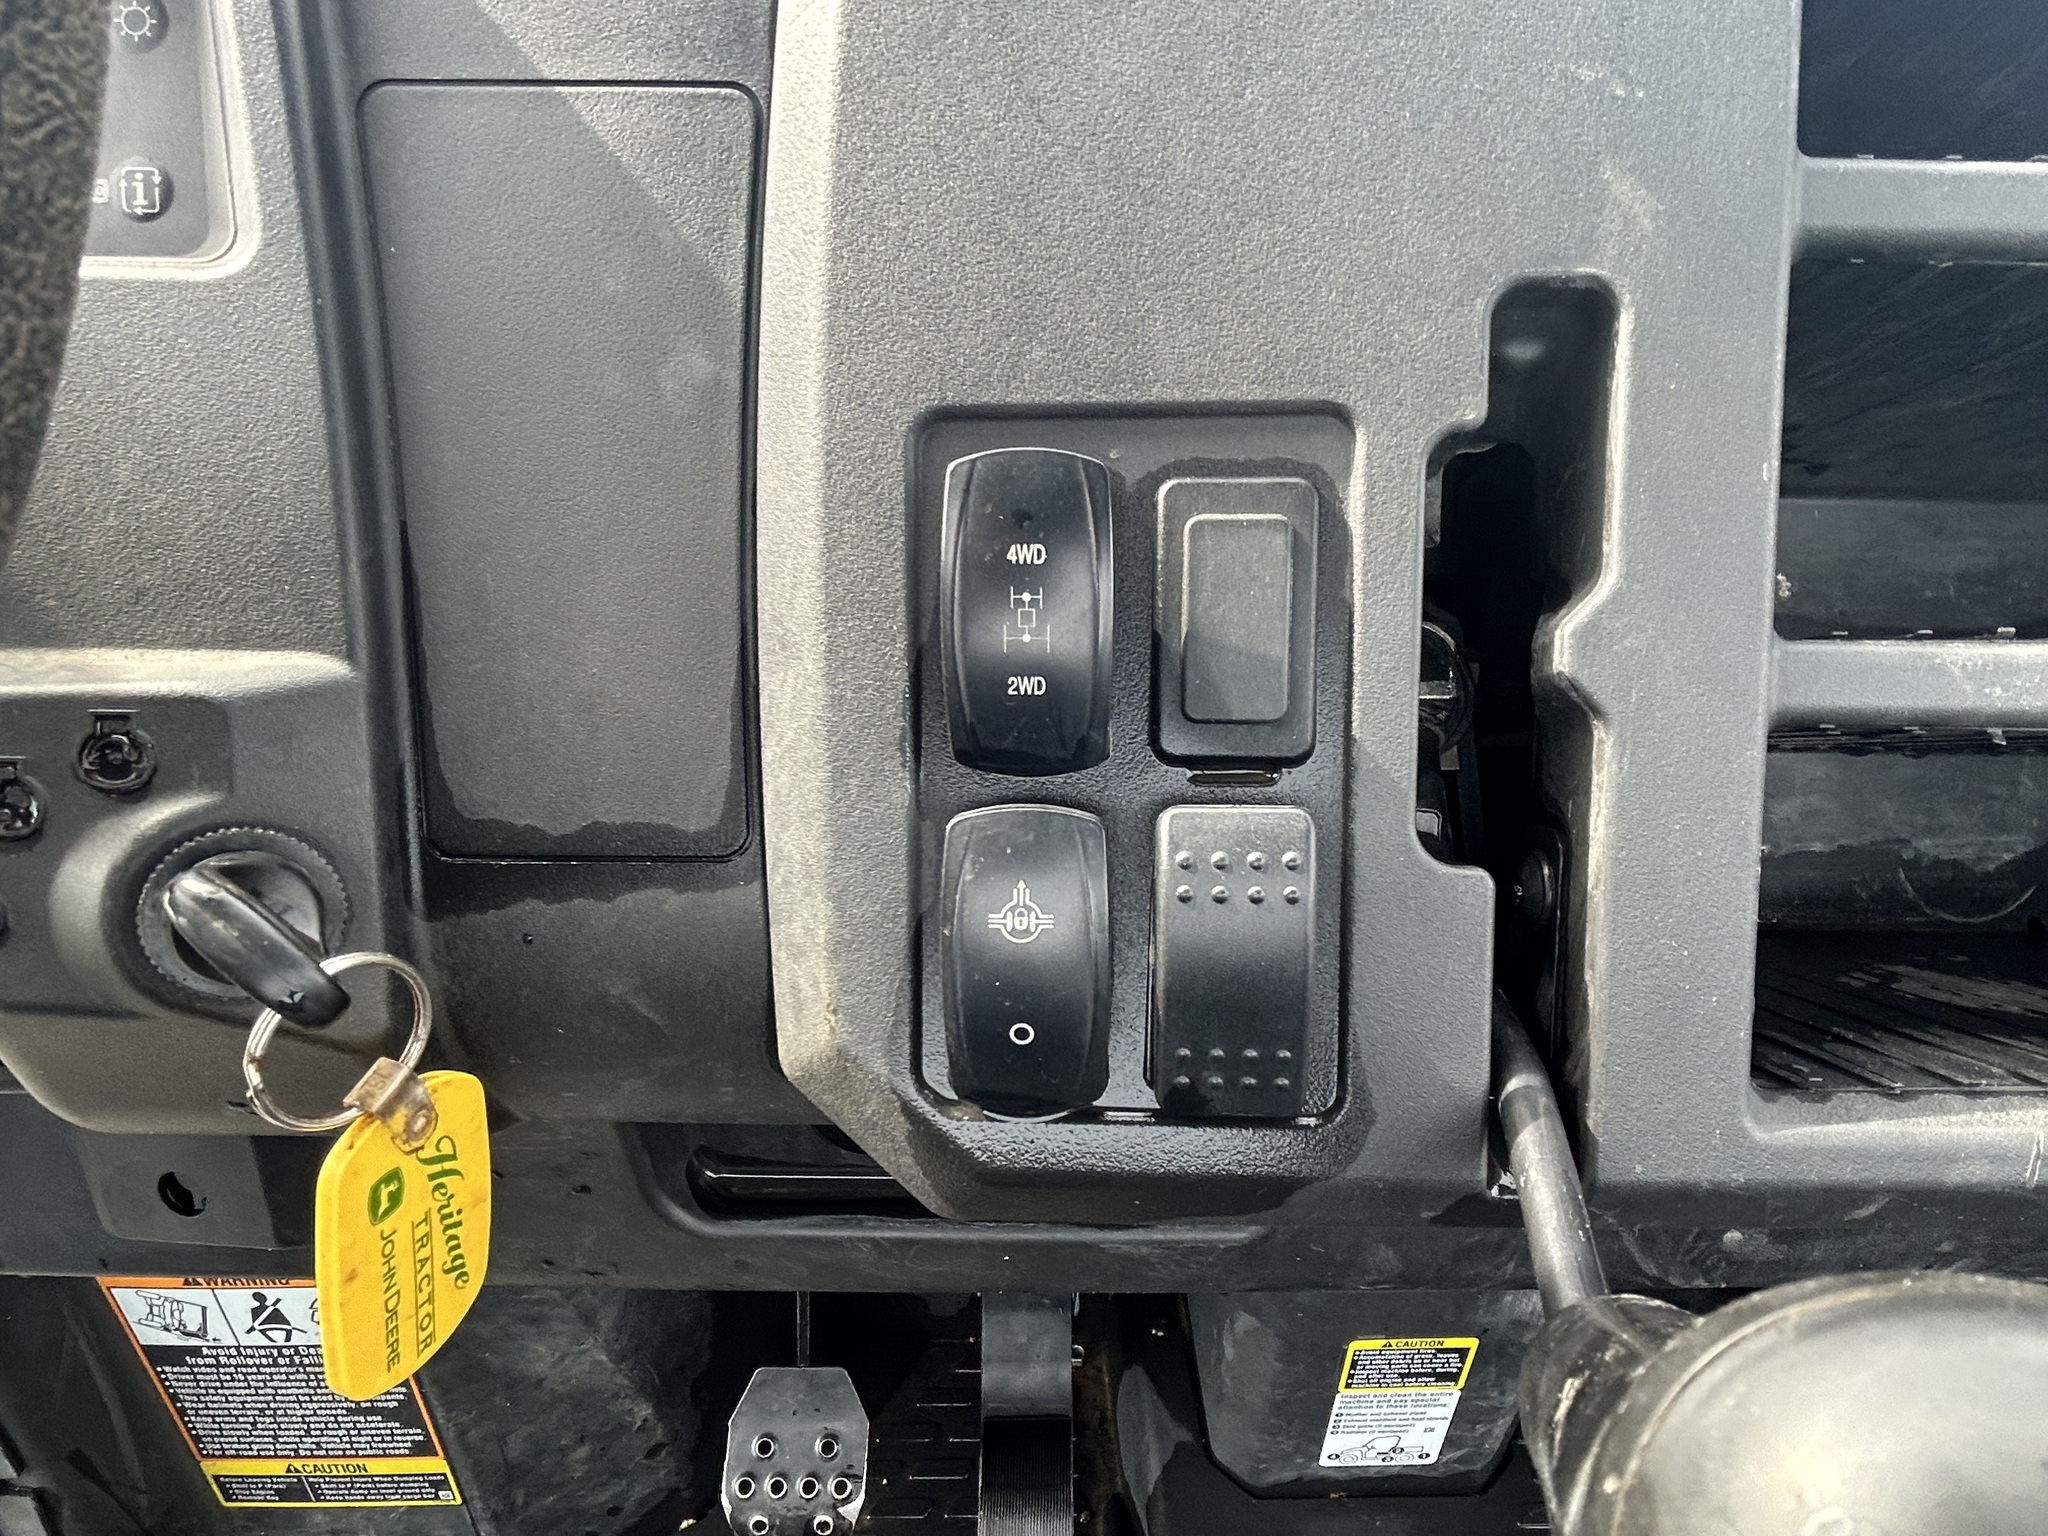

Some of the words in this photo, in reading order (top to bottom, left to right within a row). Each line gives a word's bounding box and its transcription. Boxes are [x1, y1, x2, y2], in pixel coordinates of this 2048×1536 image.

[1006, 544, 1047, 565] 4WD
[1007, 676, 1047, 696] 2WD
[416, 1135, 471, 1290] Heritage
[414, 1210, 434, 1354] TRACTOR
[202, 1347, 237, 1355] Avoid
[240, 1347, 278, 1356] Injury
[282, 1346, 294, 1355] or
[298, 1346, 324, 1355] Dea
[1395, 1340, 1445, 1348] CAUTION
[185, 1356, 216, 1365] from
[219, 1356, 273, 1364] Rollover
[277, 1356, 290, 1364] or
[293, 1356, 323, 1364] Falli
[301, 1463, 368, 1474] CAUTION
